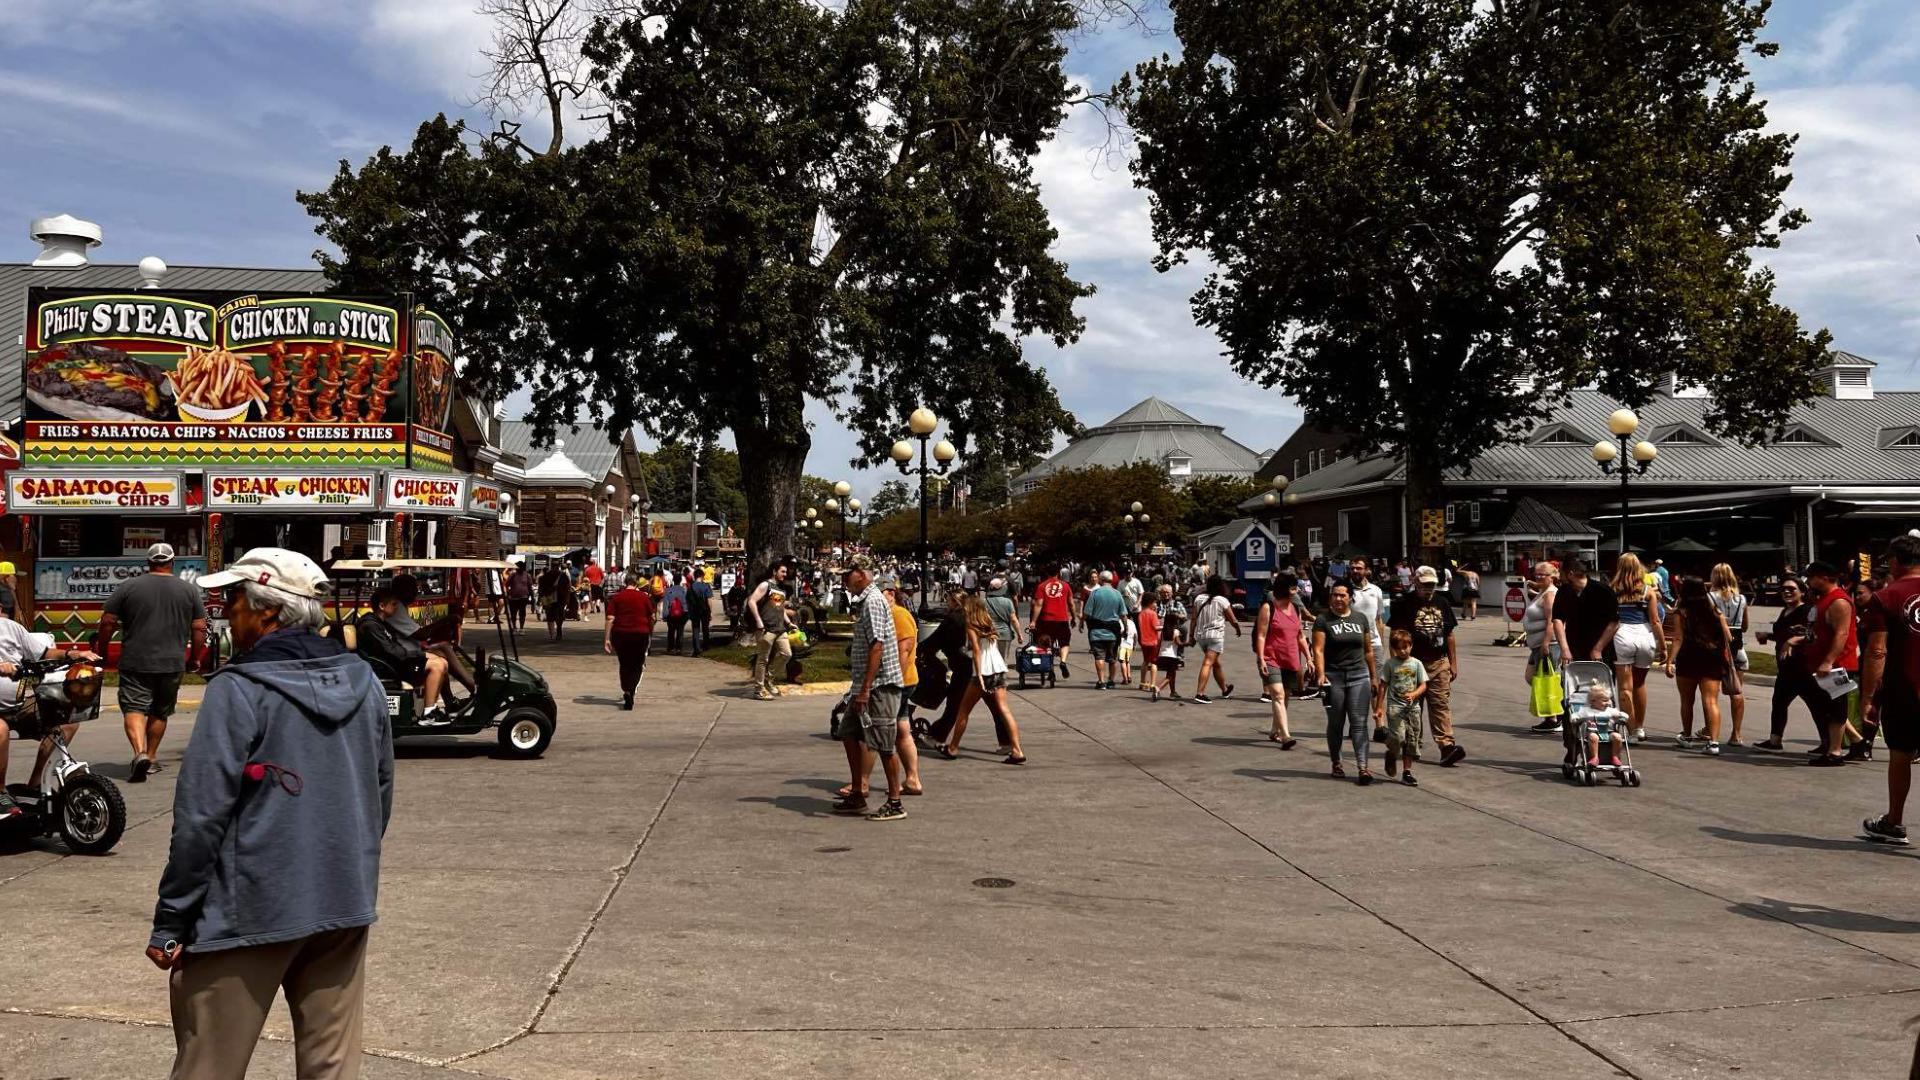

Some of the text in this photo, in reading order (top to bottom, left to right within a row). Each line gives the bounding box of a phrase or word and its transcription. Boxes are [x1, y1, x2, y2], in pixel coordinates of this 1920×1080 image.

[218, 296, 258, 318] CAJUN
[44, 303, 209, 342] Philly STEAK
[230, 307, 391, 344] CHICKEN on a STICK
[38, 425, 393, 440] FRIES SARATOGA CHIPS NACHOS CHEESE FRIES
[21, 478, 149, 500] SARATOGA
[212, 477, 371, 498] STEAK & CHICKEN
[393, 478, 459, 499] CHICKEN
[117, 494, 170, 507] CHIPS
[230, 494, 264, 505] Philly
[318, 494, 351, 505] Philly
[427, 495, 456, 507] Stick
[1249, 539, 1262, 555] ?
[73, 565, 150, 580] ICE CO
[69, 584, 119, 593] BOTTLE
[1331, 622, 1363, 635] WSU
